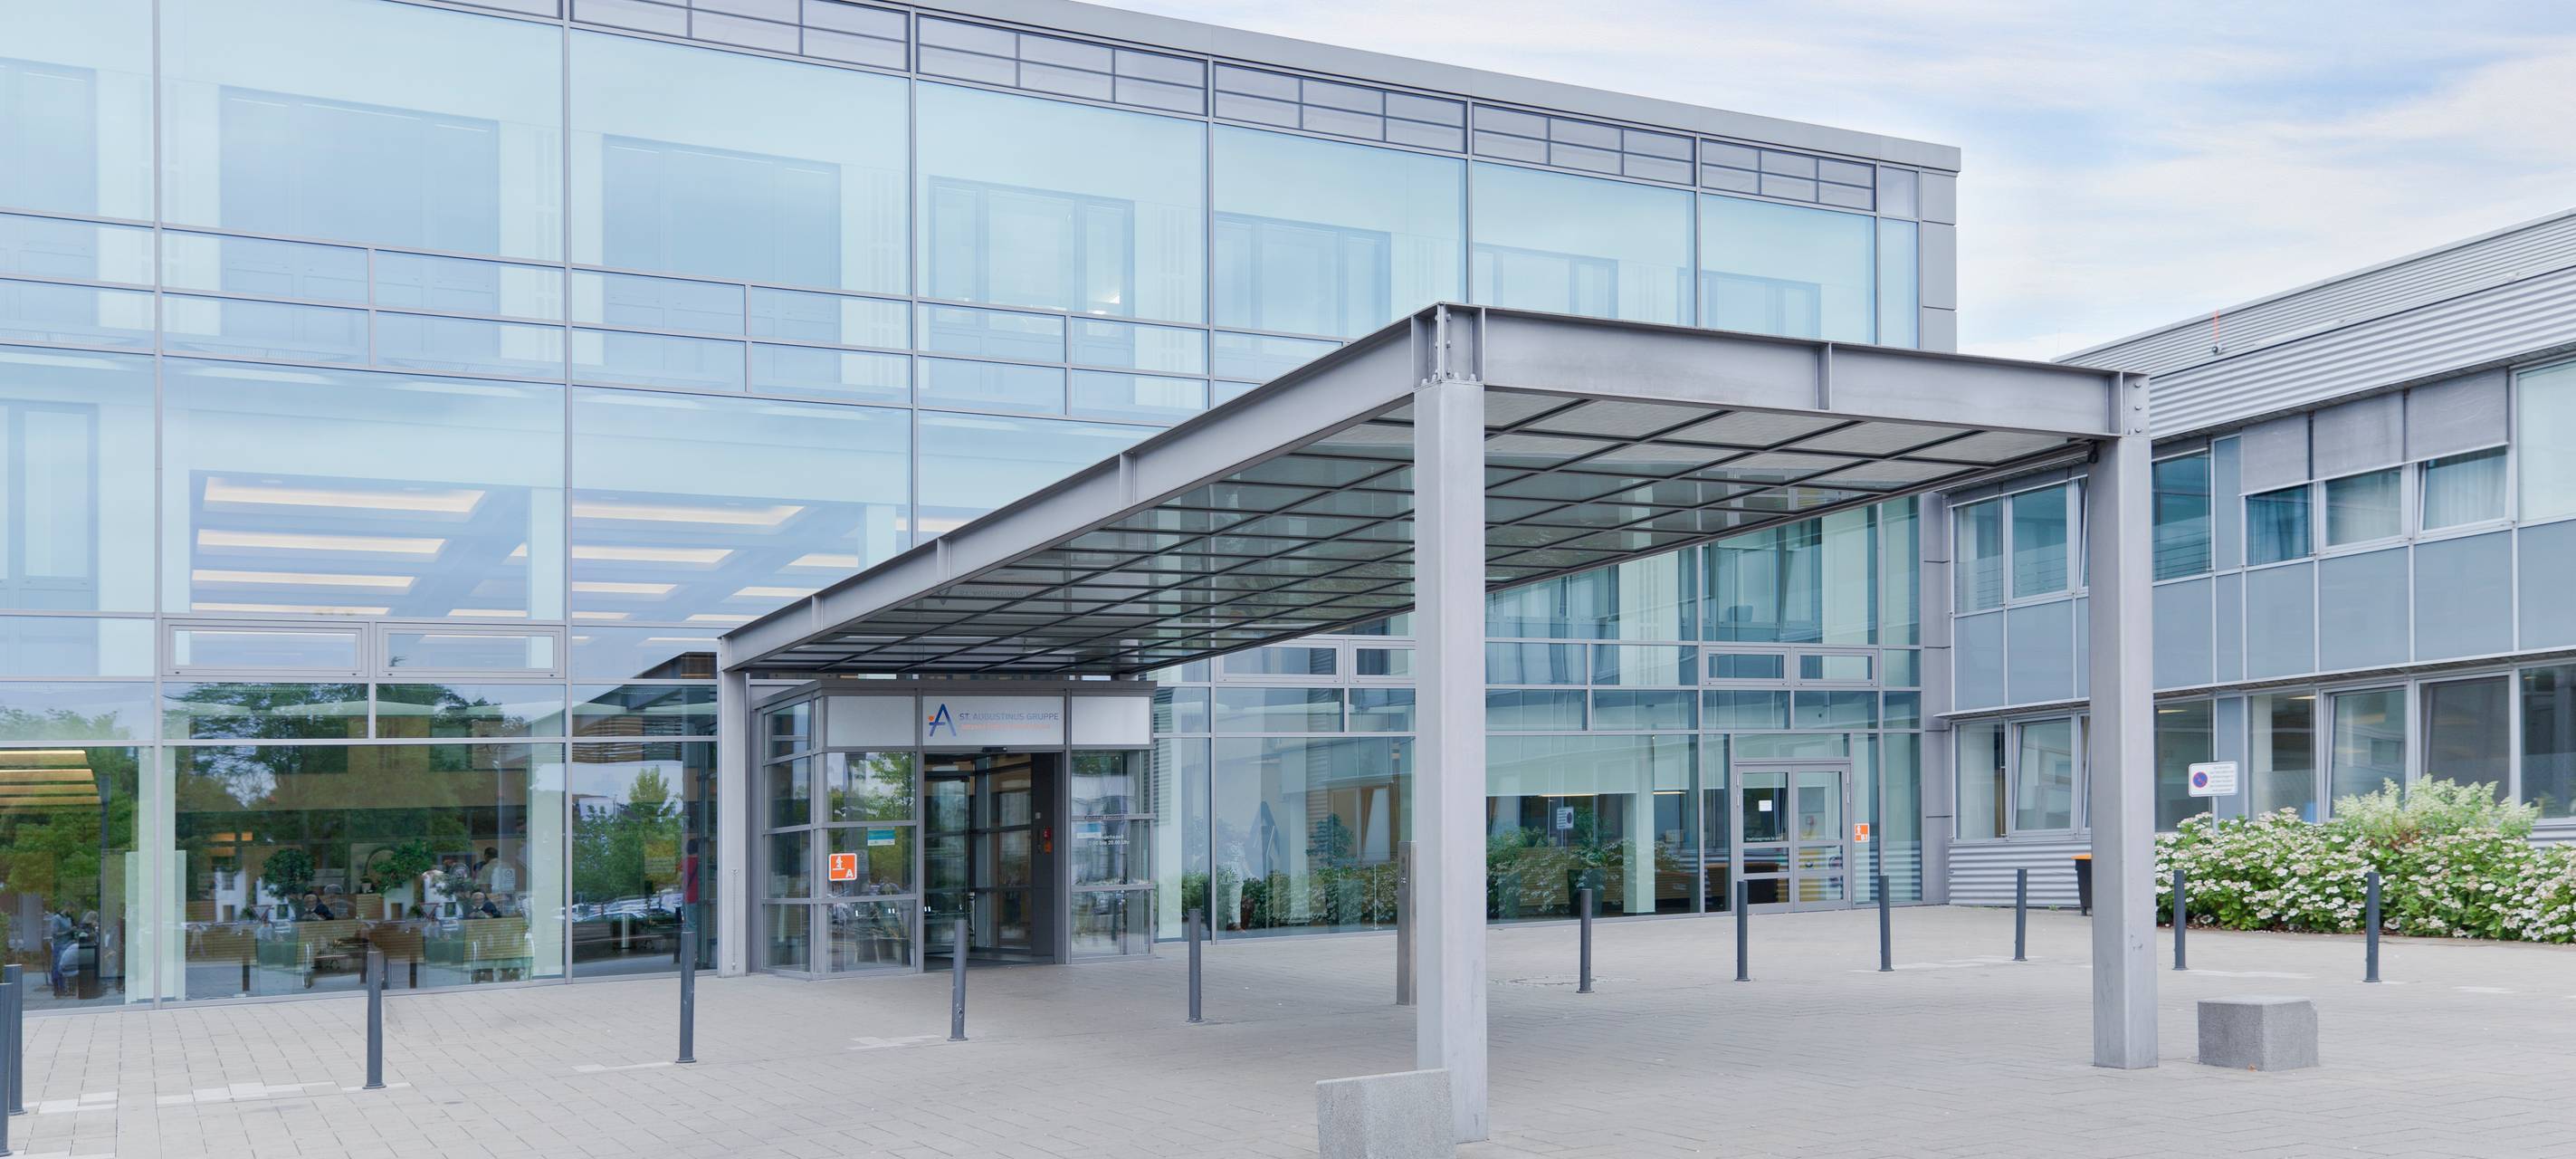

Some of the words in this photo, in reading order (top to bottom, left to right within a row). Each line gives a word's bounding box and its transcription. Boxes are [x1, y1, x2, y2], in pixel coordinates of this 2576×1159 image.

[972, 713, 1025, 721] AUGUSTINUS
[1026, 713, 1059, 721] GRUPPE
[845, 868, 854, 878] A
